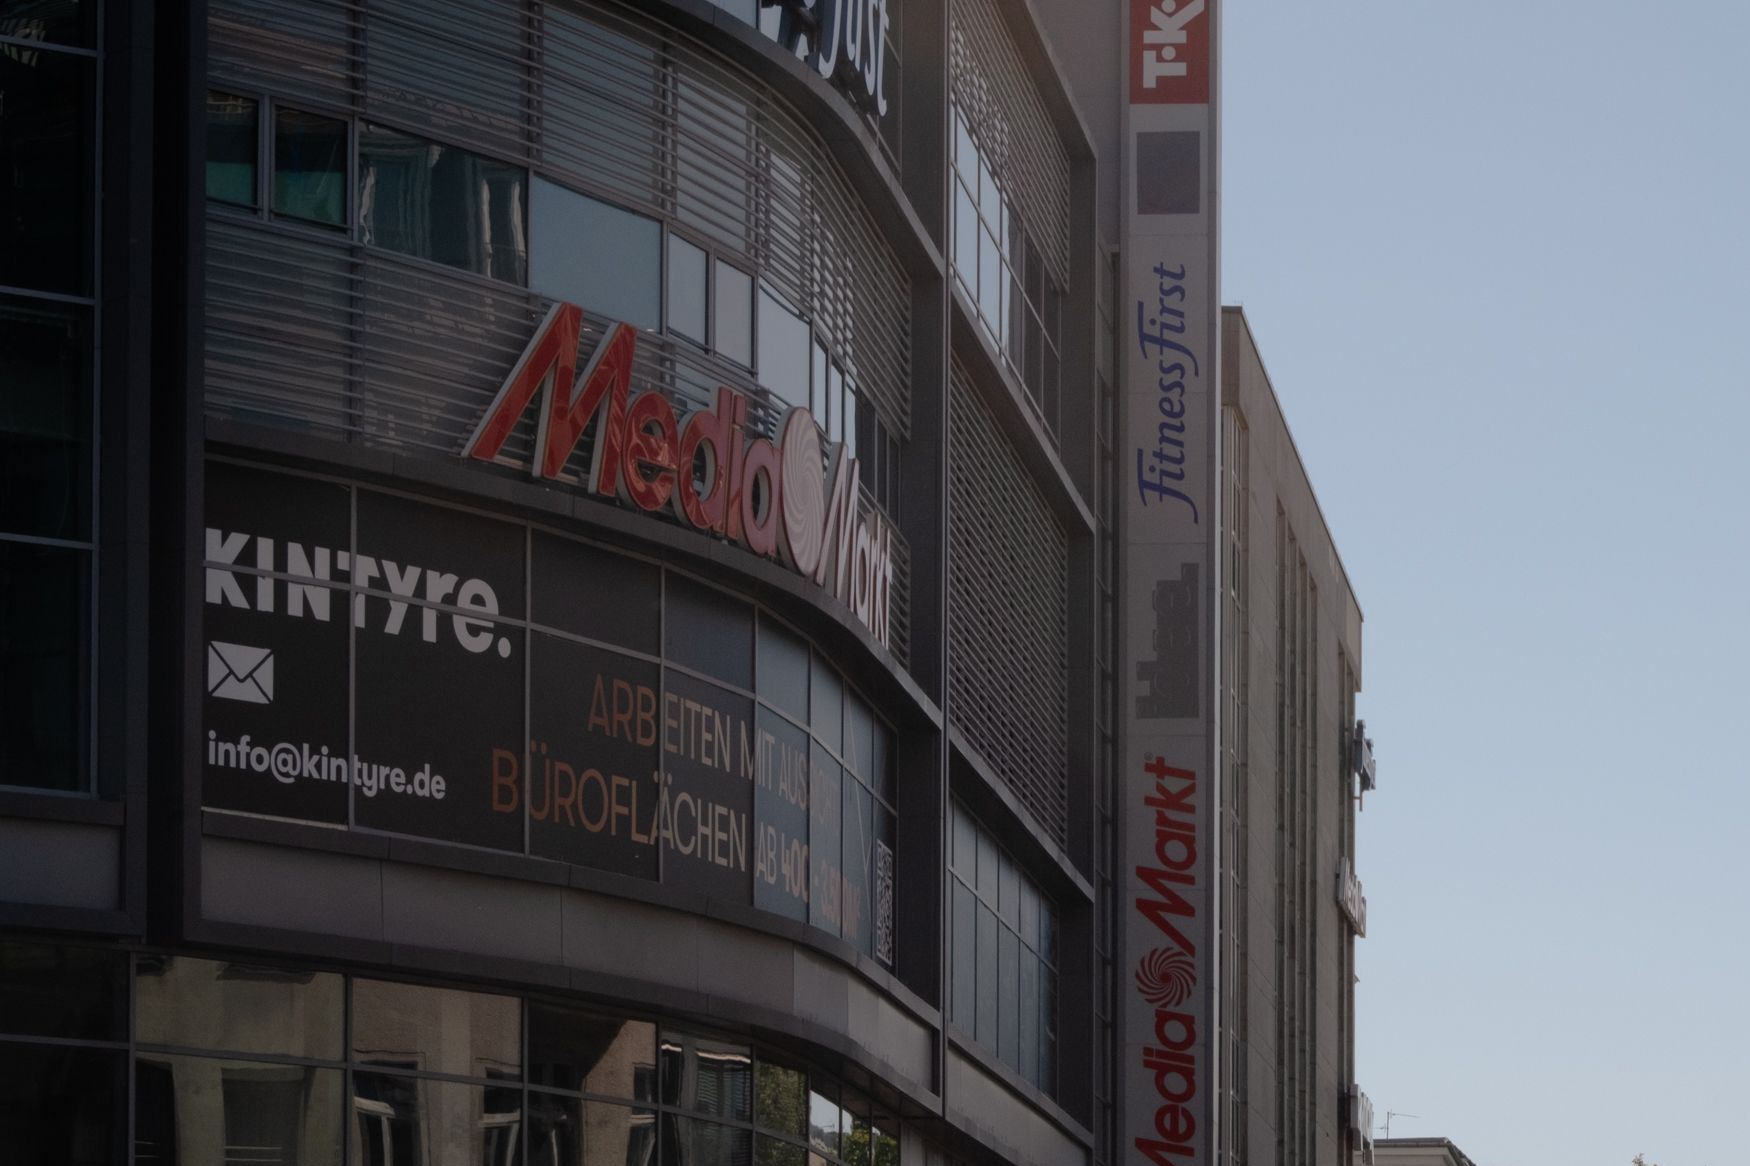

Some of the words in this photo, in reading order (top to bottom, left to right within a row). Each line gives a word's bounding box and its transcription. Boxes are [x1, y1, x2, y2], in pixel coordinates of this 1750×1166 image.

[1138, 262, 1199, 377] First
[1137, 359, 1199, 525] Fitness
[207, 730, 447, 801] info@kintyre.de
[587, 673, 731, 775] ARBEITEN
[740, 719, 776, 791] MIT
[491, 741, 746, 873] BÜROFLÄCHEN
[756, 822, 776, 885] AB
